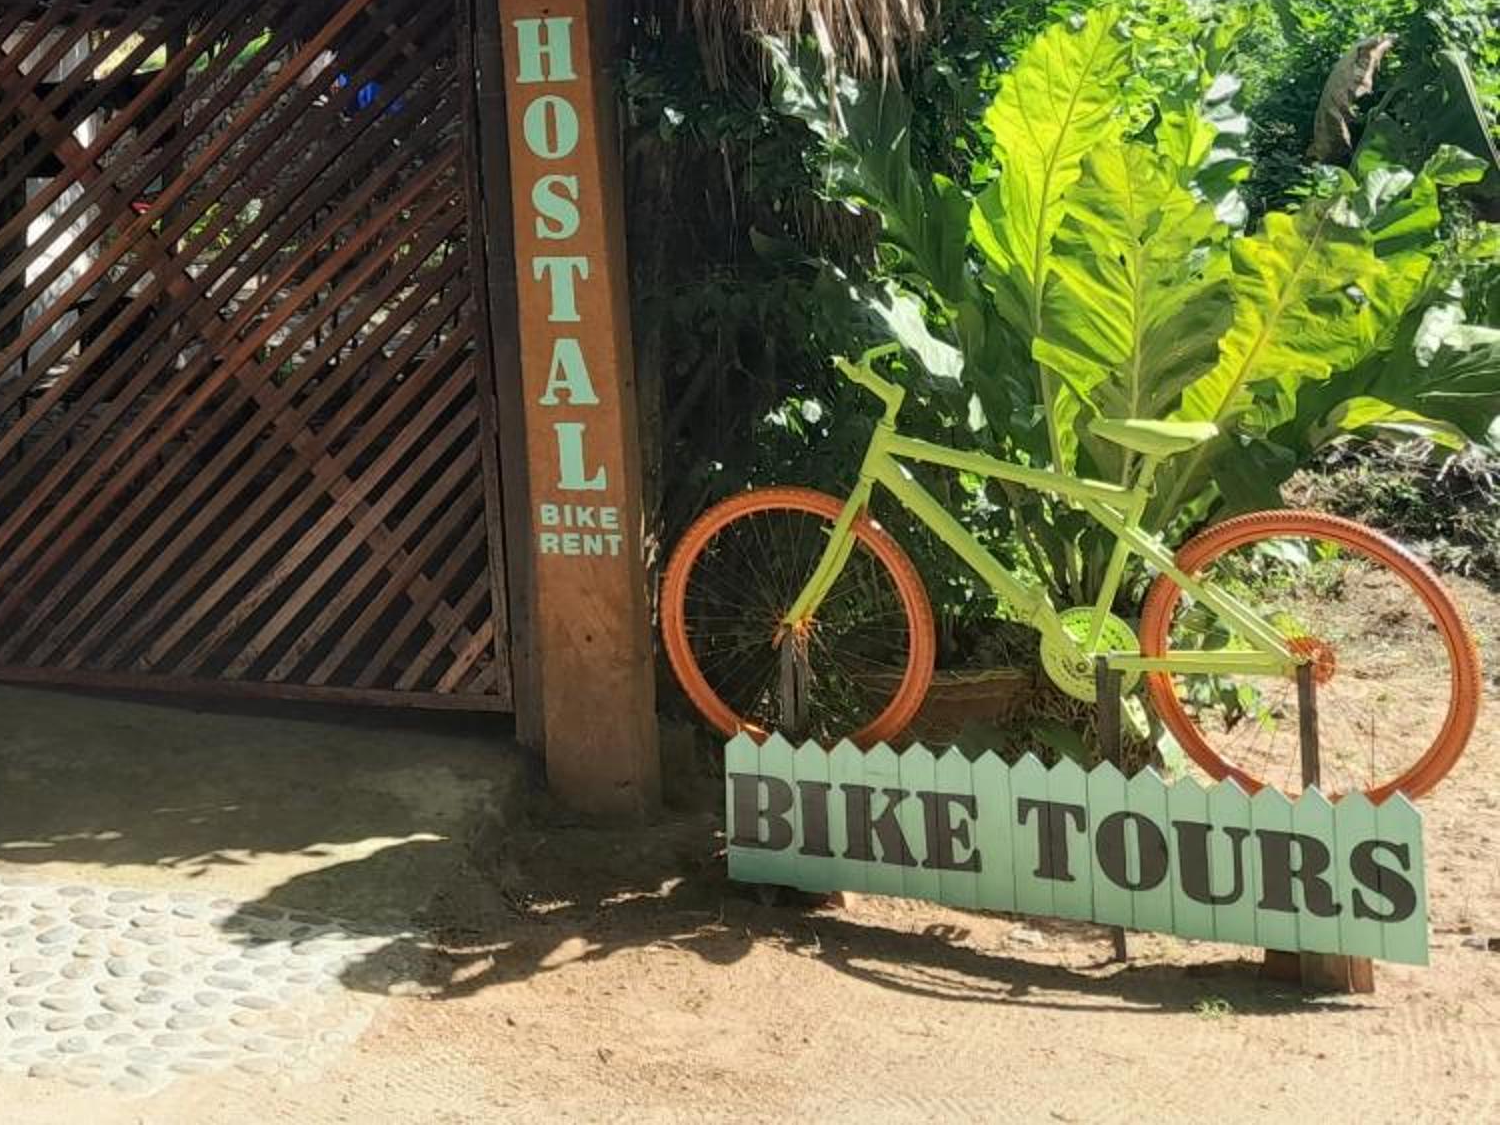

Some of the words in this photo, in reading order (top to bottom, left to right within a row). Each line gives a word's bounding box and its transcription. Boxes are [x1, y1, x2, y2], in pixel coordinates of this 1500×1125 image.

[513, 17, 607, 491] HOSTAL
[541, 505, 619, 530] BIKE
[541, 532, 623, 556] RENT
[728, 772, 982, 874] BIKE
[1017, 798, 1418, 924] TOURS
